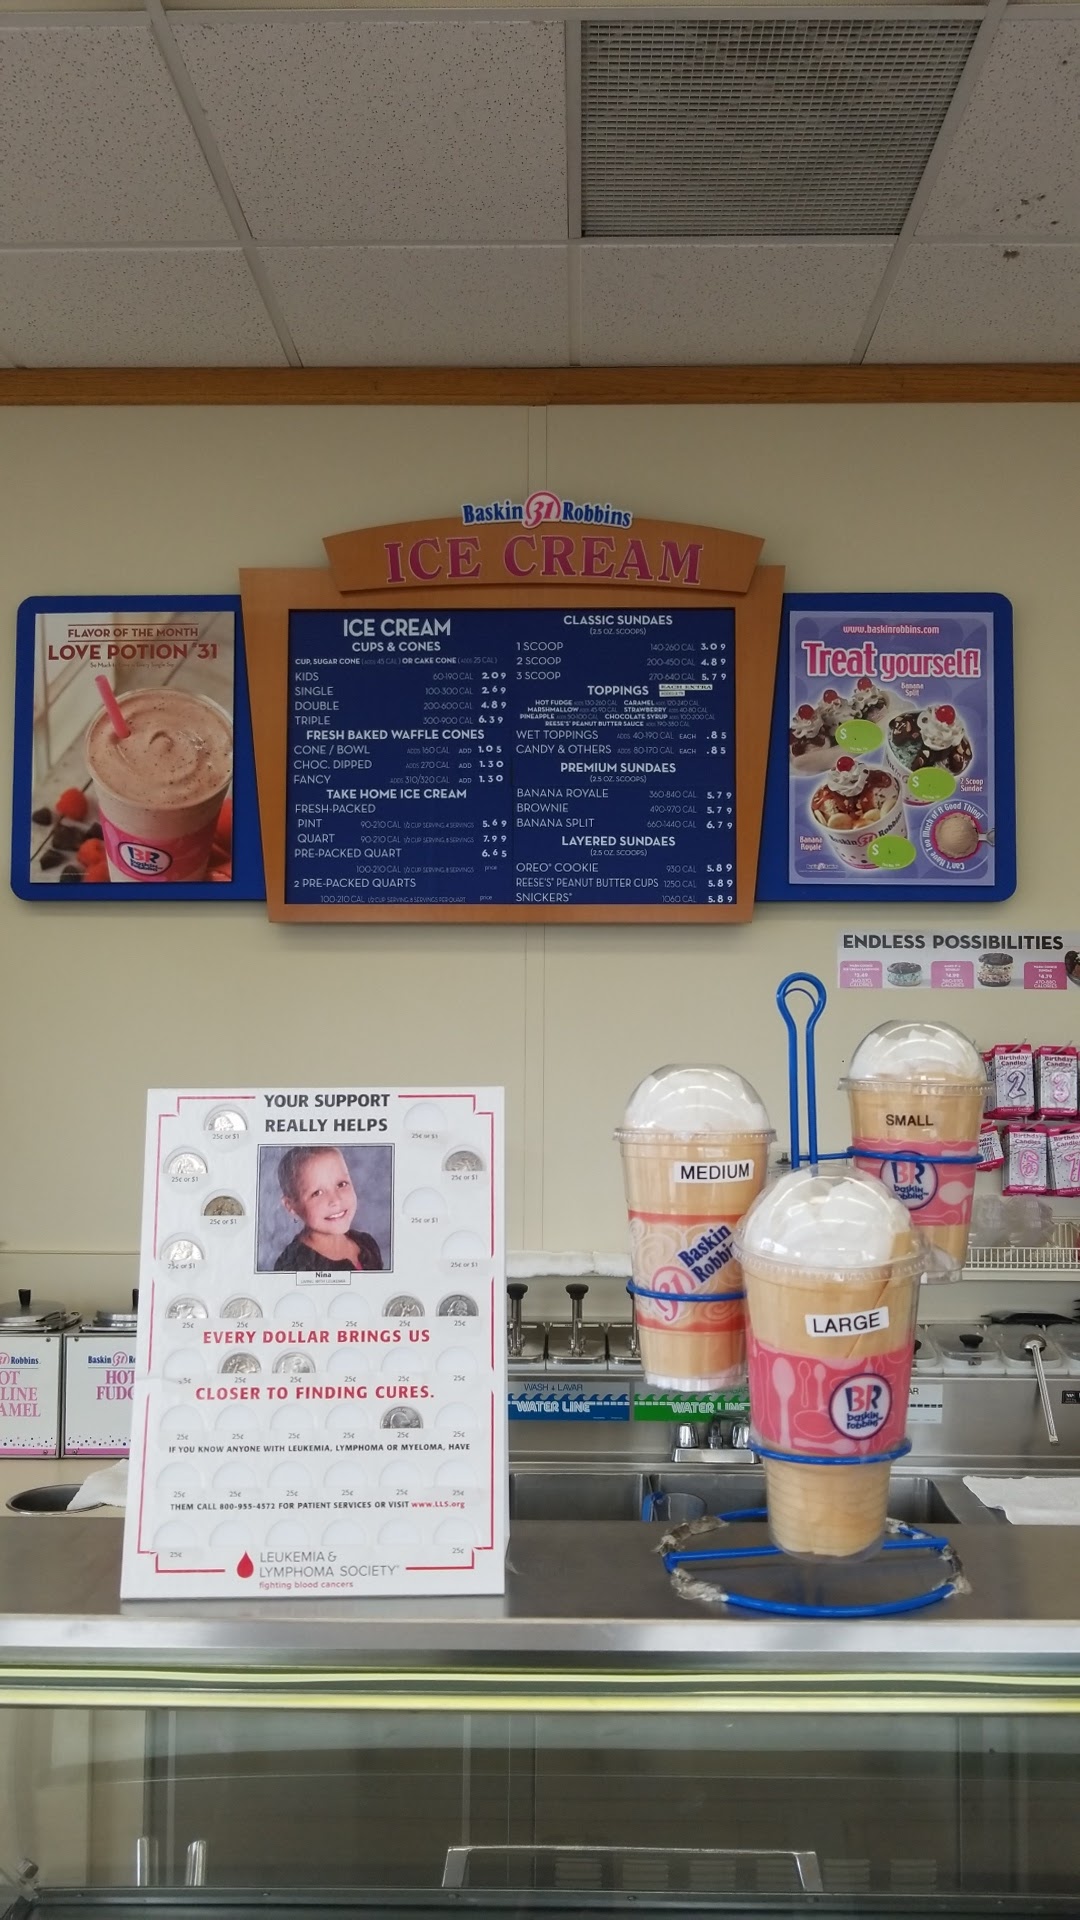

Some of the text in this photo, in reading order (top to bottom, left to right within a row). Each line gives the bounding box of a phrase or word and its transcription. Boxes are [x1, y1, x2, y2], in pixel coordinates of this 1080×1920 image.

[463, 495, 631, 527] Baskin 31 Robbins
[385, 535, 704, 584] ICE CREAM
[564, 615, 673, 625] CLASSIC SUNDAES
[344, 618, 451, 637] ICE CREAM
[843, 625, 940, 635] www.baskinrobbins.com
[68, 628, 198, 638] FLAVOR OF THE MONTH
[352, 642, 441, 651] CUPS & CONES
[524, 642, 564, 651] SCOOP
[48, 645, 101, 660] LOVE
[107, 644, 187, 660] POTION
[516, 657, 561, 666] 2 SCOOP
[803, 641, 980, 680] Treat yourself!
[295, 672, 319, 681] KIDS
[516, 672, 522, 680] 3
[525, 672, 561, 680] SCOOP
[295, 687, 333, 696] SINGLE
[588, 686, 649, 696] TOPPINGS
[905, 689, 920, 698] Split
[295, 702, 339, 710] DOUBLE
[295, 716, 331, 725] TRIPLE
[307, 730, 484, 740] FRESH BAKED WAFFLE CONES
[516, 730, 599, 740] WET TOPPINGS
[294, 745, 370, 755] CONE BOWL
[516, 745, 612, 755] CANDY & OTHERS
[333, 760, 372, 769] DIPPED
[561, 763, 676, 773] PREMIUM SUNDAES
[294, 775, 331, 784] FANCY
[966, 777, 984, 787] Scoop
[326, 789, 467, 799] TAKE HOME ICE CREAM
[517, 789, 608, 798] BANANA ROYALE
[295, 804, 376, 813] FRESH-PACKED
[517, 803, 568, 813] BROWNIE
[944, 802, 962, 810] Good
[298, 819, 322, 828] PINT
[517, 818, 594, 828] BANANA SPLIT
[297, 834, 335, 844] QUART
[562, 836, 676, 846] LAYERED SUNDAES
[800, 835, 822, 843] Banana
[295, 849, 402, 858] PRE-PACKED QUART
[555, 863, 598, 872] COOKIE
[303, 879, 416, 888] PRE-PACKED QUARTS
[557, 878, 658, 888] PEANUT BUTTER CUPS
[843, 934, 1064, 951] ENDLESS POSSIBILITIES
[264, 1094, 390, 1107] YOUR SUPPORT
[265, 1118, 388, 1132] REALLY HELPS
[886, 1114, 934, 1126] SMALL
[681, 1163, 750, 1180] MEDIUM
[678, 1225, 732, 1267] Baskin
[315, 1271, 332, 1279] Nina
[813, 1312, 880, 1333] LARGE
[203, 1330, 430, 1344] EVERY DOLLAR BRINGS US
[11, 1356, 39, 1364] Robbins
[88, 1355, 111, 1364] Baskin
[524, 1383, 583, 1391] WASH LAVAR
[196, 1385, 434, 1400] CLOSER TO FINDING CURES.
[845, 1385, 882, 1411] BR
[516, 1401, 590, 1412] WATER LINE
[671, 1402, 714, 1413] WATER
[288, 1444, 332, 1452] LEUKEMIA,
[171, 1503, 194, 1511] THEM
[411, 1501, 465, 1509] www.LLS.org
[260, 1552, 337, 1563] LEUKEMIA &
[260, 1566, 334, 1577] LYMPHOMA
[259, 1581, 292, 1590] fighting
[294, 1581, 318, 1589] blood
